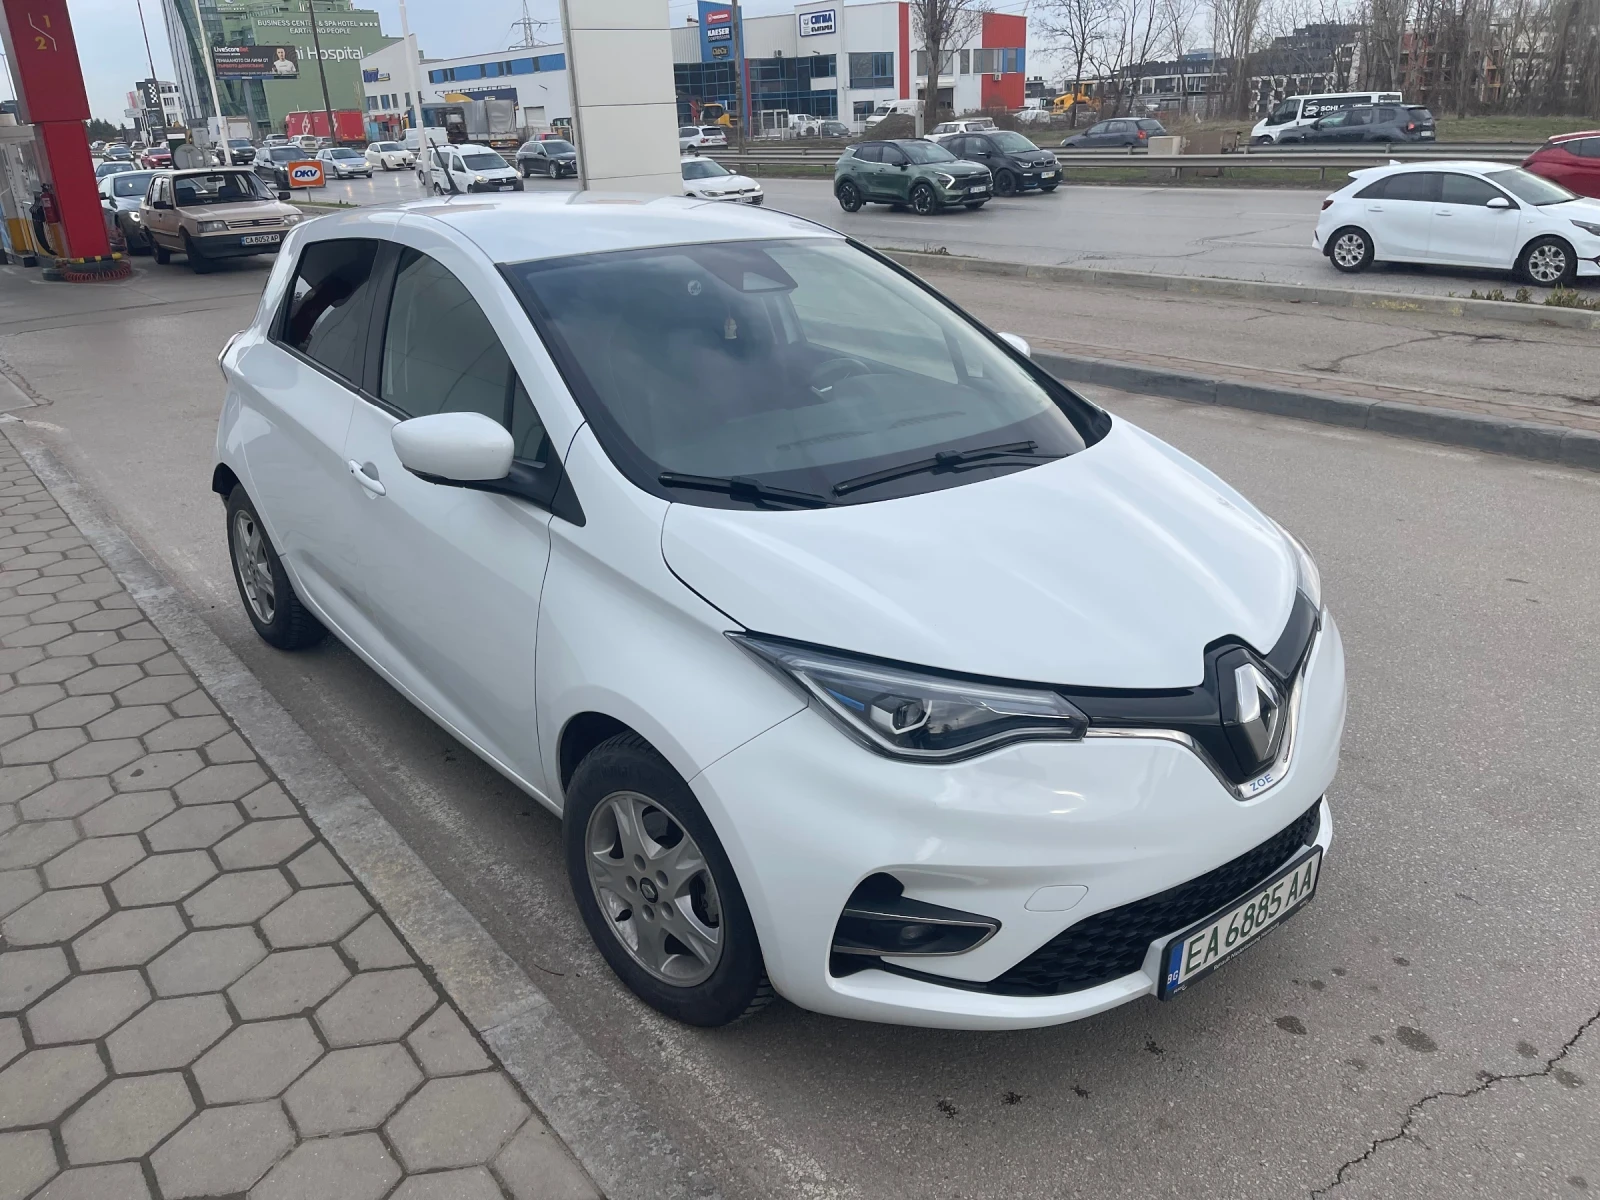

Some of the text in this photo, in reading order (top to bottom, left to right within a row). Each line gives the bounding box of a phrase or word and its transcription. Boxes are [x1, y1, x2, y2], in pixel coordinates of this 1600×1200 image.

[42, 14, 51, 28] 1
[707, 28, 729, 37] KAESER
[35, 36, 47, 50] 2
[306, 46, 364, 63] Hospital
[294, 169, 318, 178] DKV
[245, 234, 279, 245] CA 8052 AP
[1249, 773, 1273, 792] ZOE
[1184, 861, 1313, 977] EA 6885 AA
[1167, 970, 1178, 985] BG
